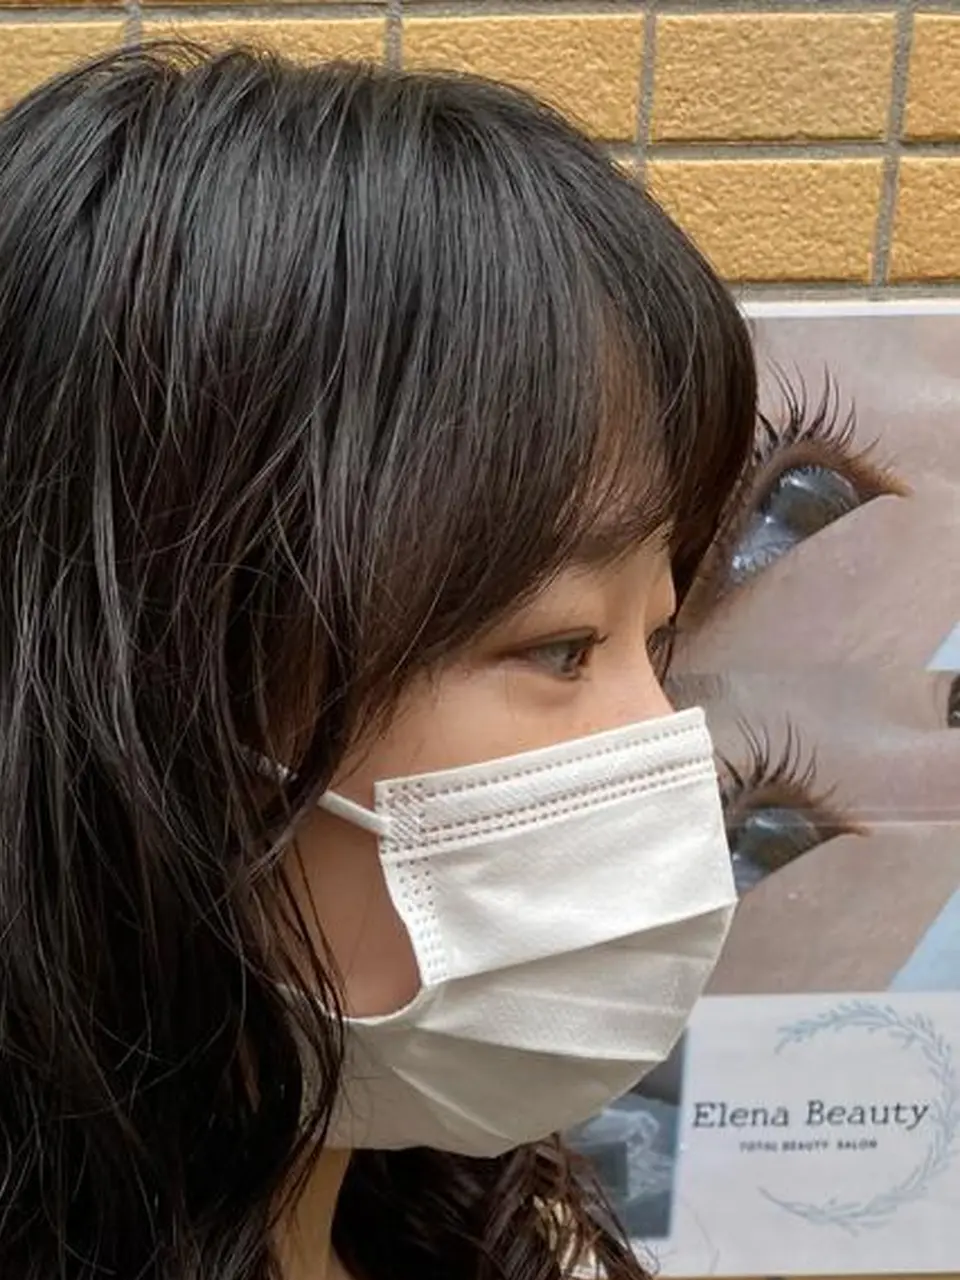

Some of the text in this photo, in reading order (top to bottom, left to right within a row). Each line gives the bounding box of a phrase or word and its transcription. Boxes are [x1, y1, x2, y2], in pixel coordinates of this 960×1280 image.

[692, 1099, 930, 1131] Elena Beauty
[781, 1139, 829, 1151] BEAUTY
[836, 1138, 878, 1150] SALON
